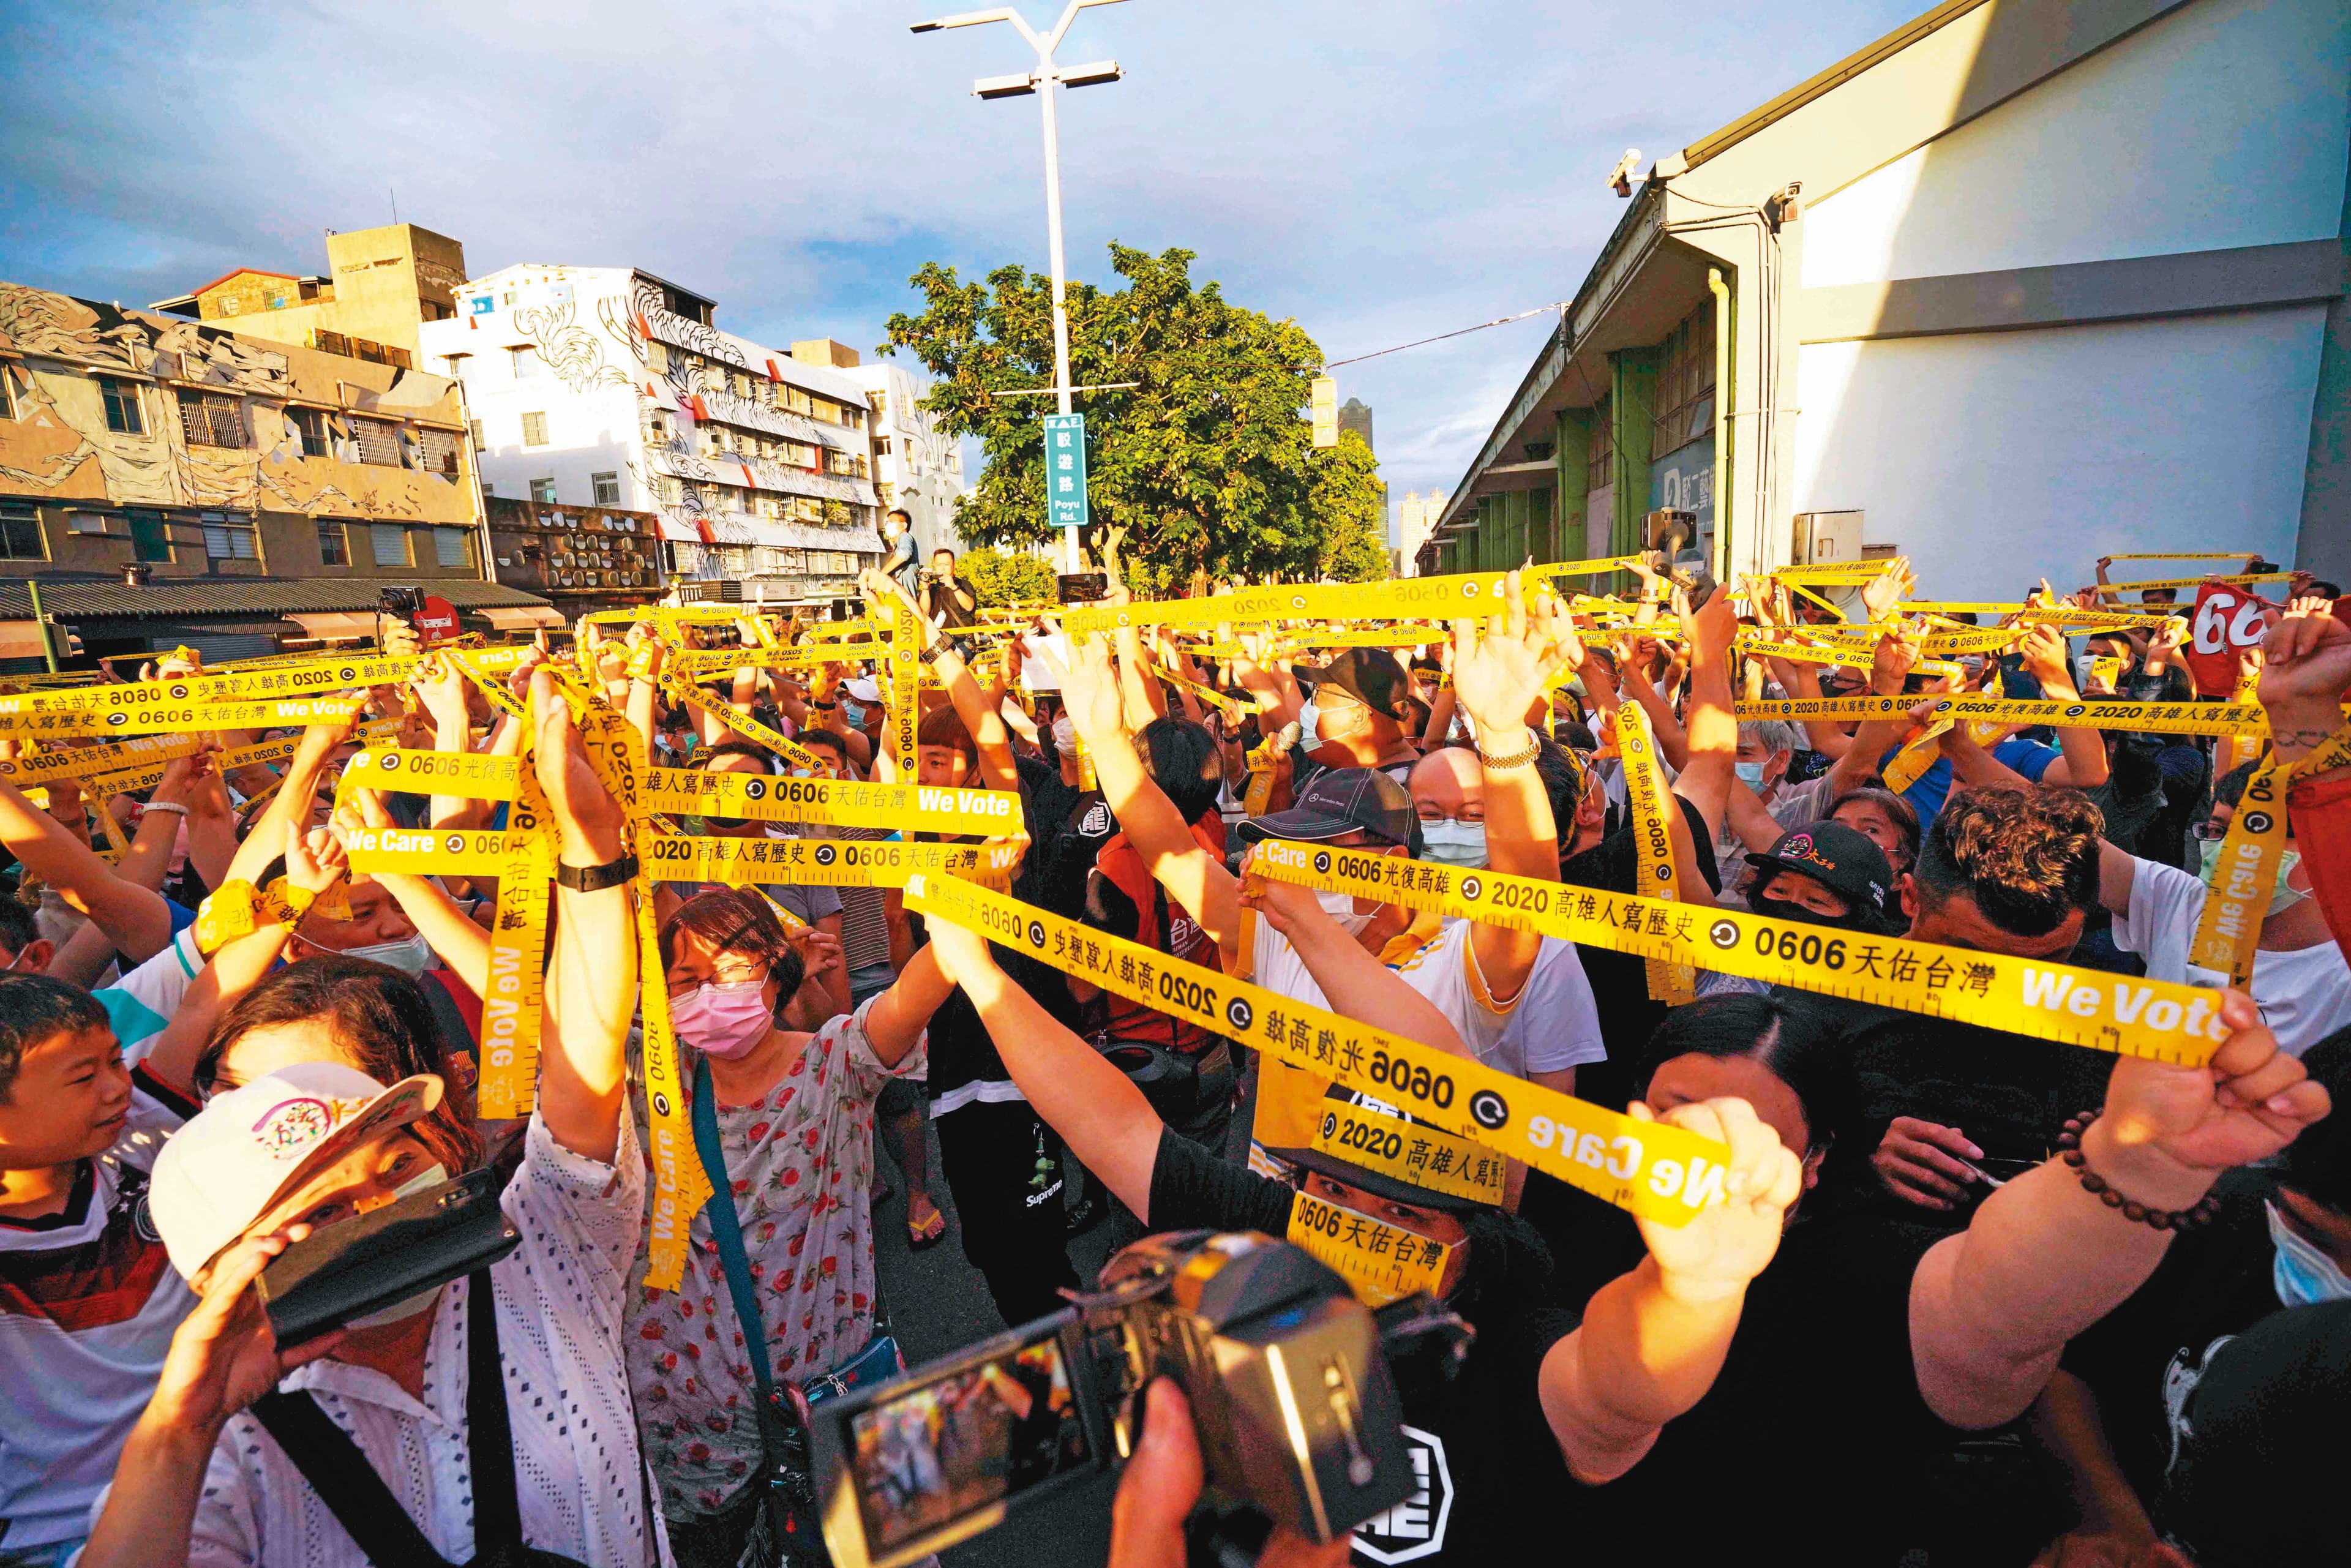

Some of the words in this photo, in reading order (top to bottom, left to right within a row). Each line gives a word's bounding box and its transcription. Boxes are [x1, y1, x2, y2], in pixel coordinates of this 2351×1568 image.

[1055, 500, 1080, 510] Poyu
[1060, 512, 1076, 521] Rd.
[1755, 643, 1780, 652] 2020
[1818, 634, 1839, 642] 0606
[1961, 636, 1983, 647] 0606
[1922, 661, 1941, 671] We
[138, 709, 193, 724] 0606
[198, 705, 267, 721] 天佑台灣
[277, 702, 309, 717] We
[312, 701, 356, 716] Vote
[1748, 703, 1778, 715] 光復高雄
[1795, 702, 1819, 713] 2020
[1821, 700, 1875, 713] 高雄人寫歷史
[1956, 702, 1998, 714] 0606
[1999, 703, 2058, 716] 光復高雄
[2090, 707, 2142, 718] 2020
[2144, 706, 2264, 722] 高雄人寫歷史
[21, 753, 69, 771] 0606
[69, 744, 124, 765] 天佑台灣
[156, 732, 190, 749] Vote
[410, 756, 460, 776] 0606
[465, 760, 517, 781] 光復高
[646, 770, 735, 797] 雄人寫歷史
[774, 781, 830, 804] 0606
[834, 785, 907, 809] 天佑台灣
[918, 789, 953, 812] We
[958, 790, 1010, 816] Vote
[348, 831, 377, 852] We
[381, 830, 435, 852] Care
[649, 840, 691, 860] 020
[697, 841, 806, 865] 高雄人寫歷史
[846, 846, 901, 866] 0606
[906, 847, 978, 869] 天佑台灣
[1267, 842, 1306, 868] Care
[1337, 857, 1381, 883] 0606
[1384, 861, 1450, 895] 光復高雄
[1492, 882, 1549, 913] 2020
[1554, 890, 1694, 943] 高雄人寫歷史
[1755, 926, 1847, 970] 0606
[1854, 944, 1997, 999] 天佑台灣
[2022, 969, 2102, 1016] We
[2112, 983, 2233, 1042] Vote
[1925, 993, 1938, 1002] 80
[2102, 1027, 2118, 1037] 90
[647, 1020, 665, 1081] 0606
[1340, 1119, 1401, 1159] 2020
[661, 1128, 676, 1193] Care
[653, 1199, 676, 1242] We
[1297, 1198, 1342, 1237] 0606
[1343, 1218, 1444, 1271] 天佑台灣
